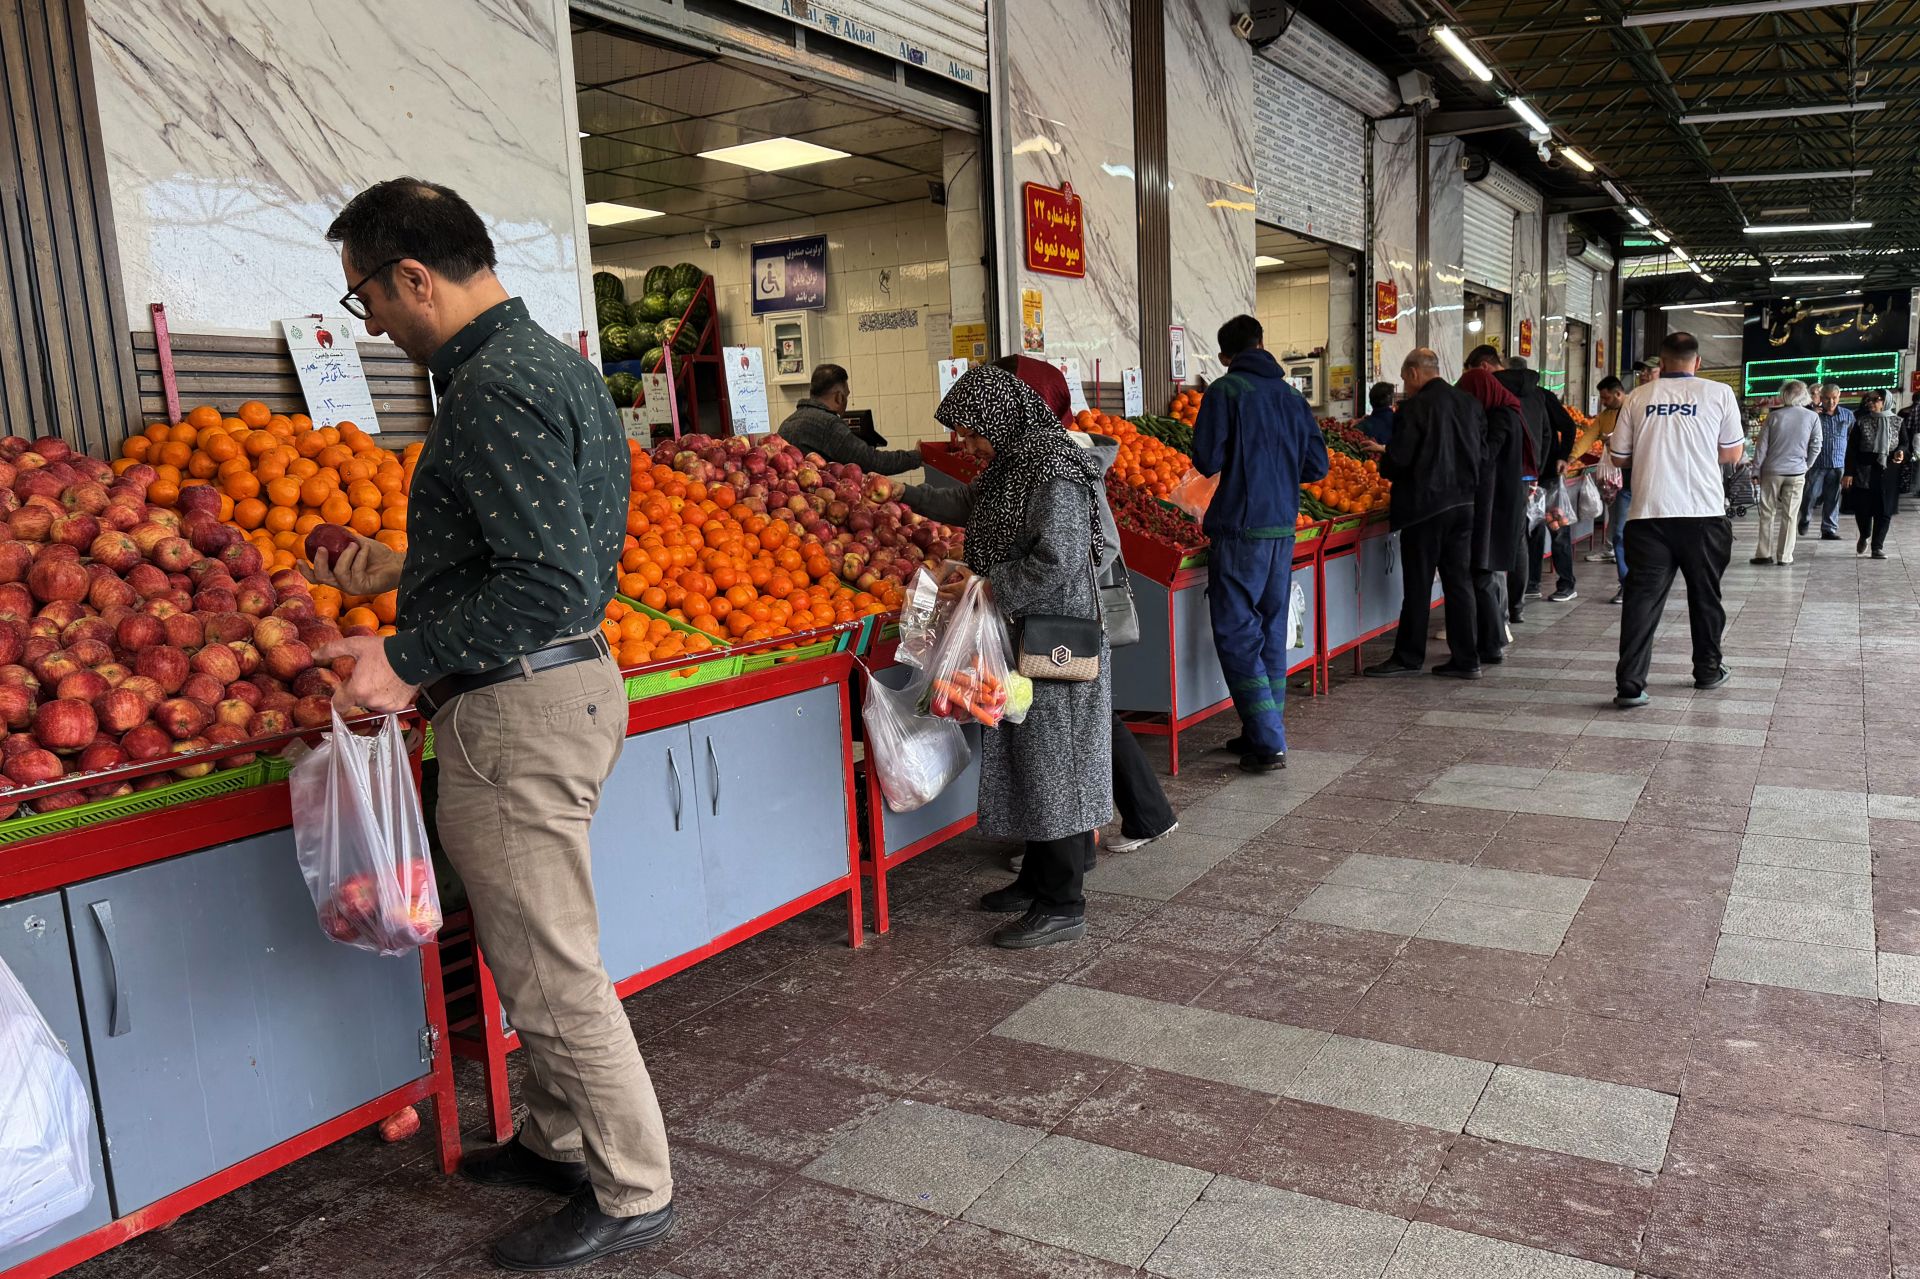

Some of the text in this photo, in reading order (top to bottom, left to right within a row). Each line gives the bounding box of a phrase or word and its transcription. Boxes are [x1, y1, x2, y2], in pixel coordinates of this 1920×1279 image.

[843, 21, 875, 44] Akpal
[948, 60, 973, 81] Akpal
[1047, 205, 1063, 227] شماره
[1064, 208, 1076, 232] غرفه
[786, 244, 823, 260] اولویت صندوق
[1034, 231, 1079, 266] میوه نمونه
[795, 292, 817, 303] می باشد
[1646, 403, 1698, 418] PEPSI
